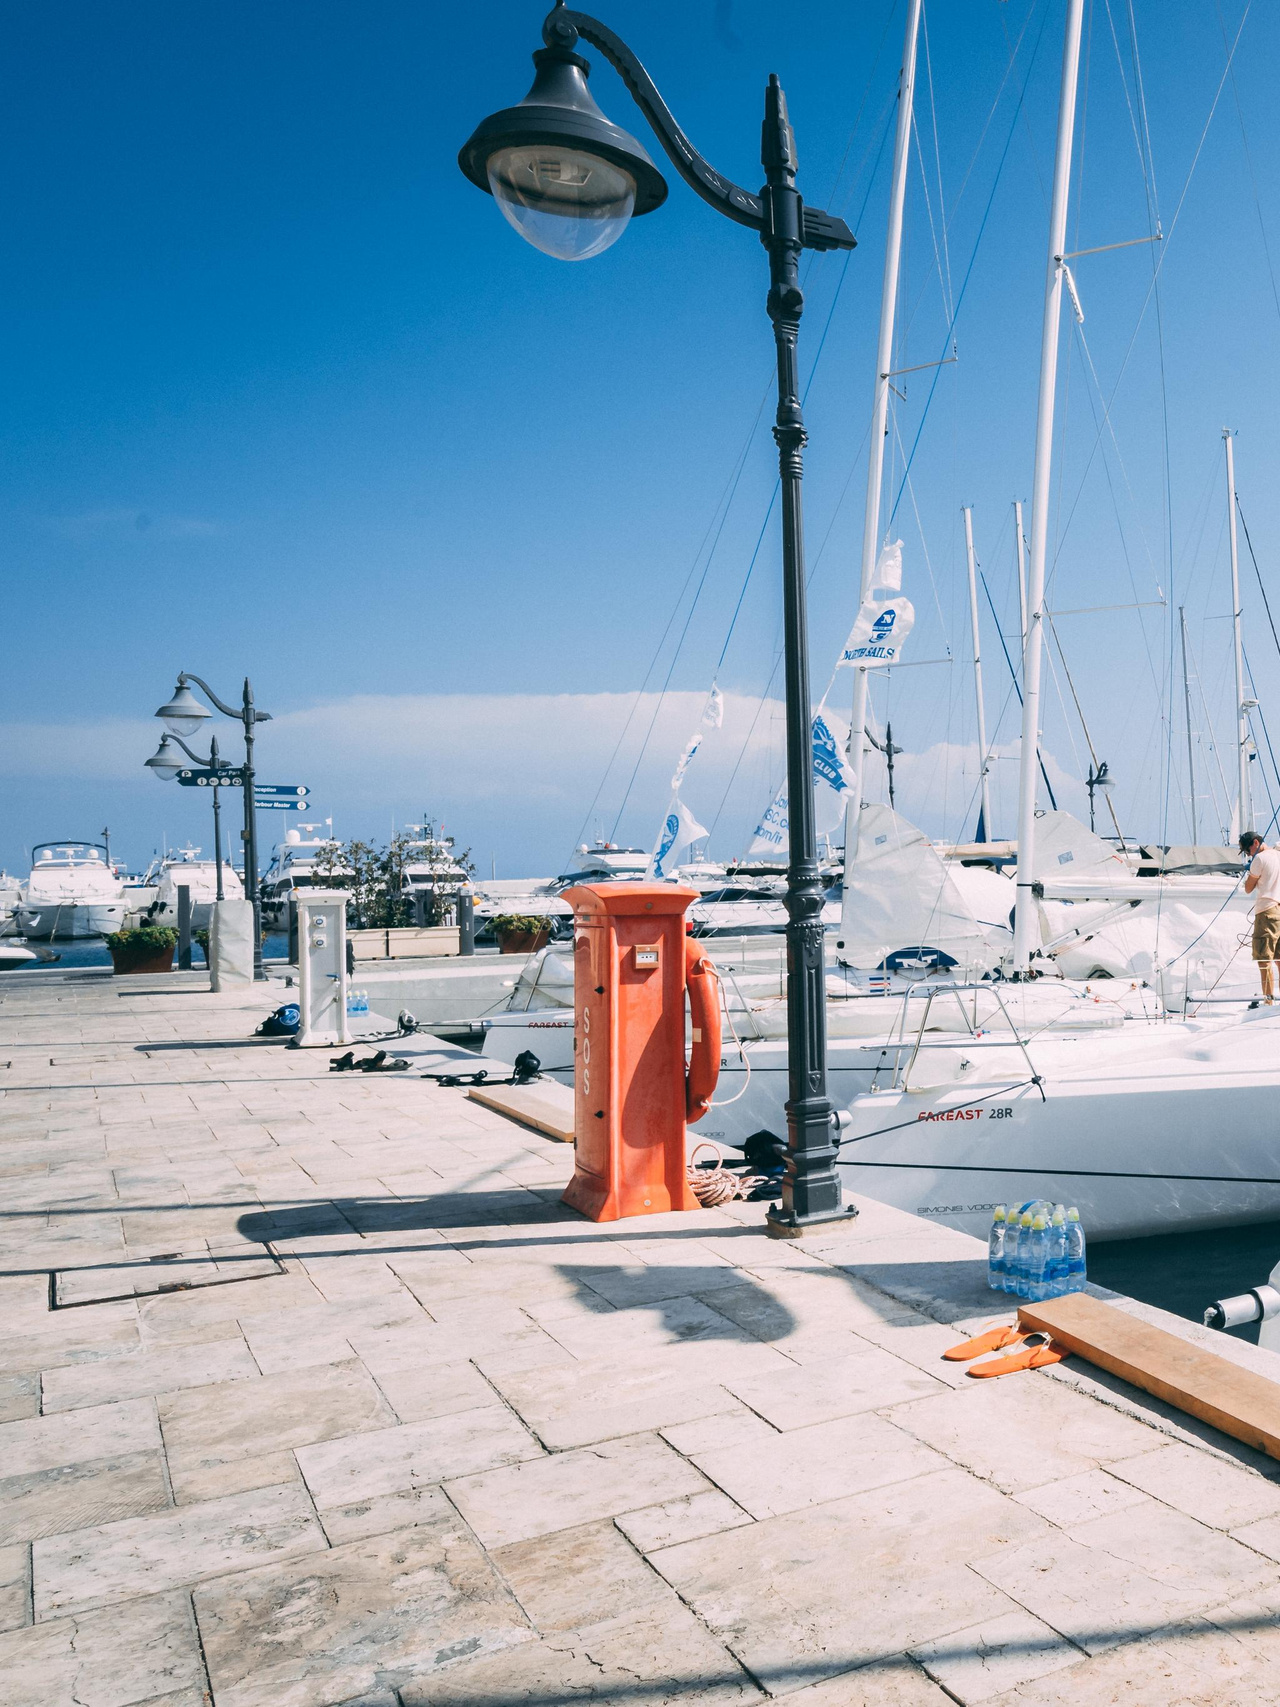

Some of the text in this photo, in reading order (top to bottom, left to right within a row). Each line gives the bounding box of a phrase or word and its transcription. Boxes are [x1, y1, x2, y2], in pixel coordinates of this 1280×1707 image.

[814, 759, 837, 779] CLUB
[918, 1108, 1013, 1122] FAREAST 28R
[917, 1205, 963, 1214] SIMONIS
